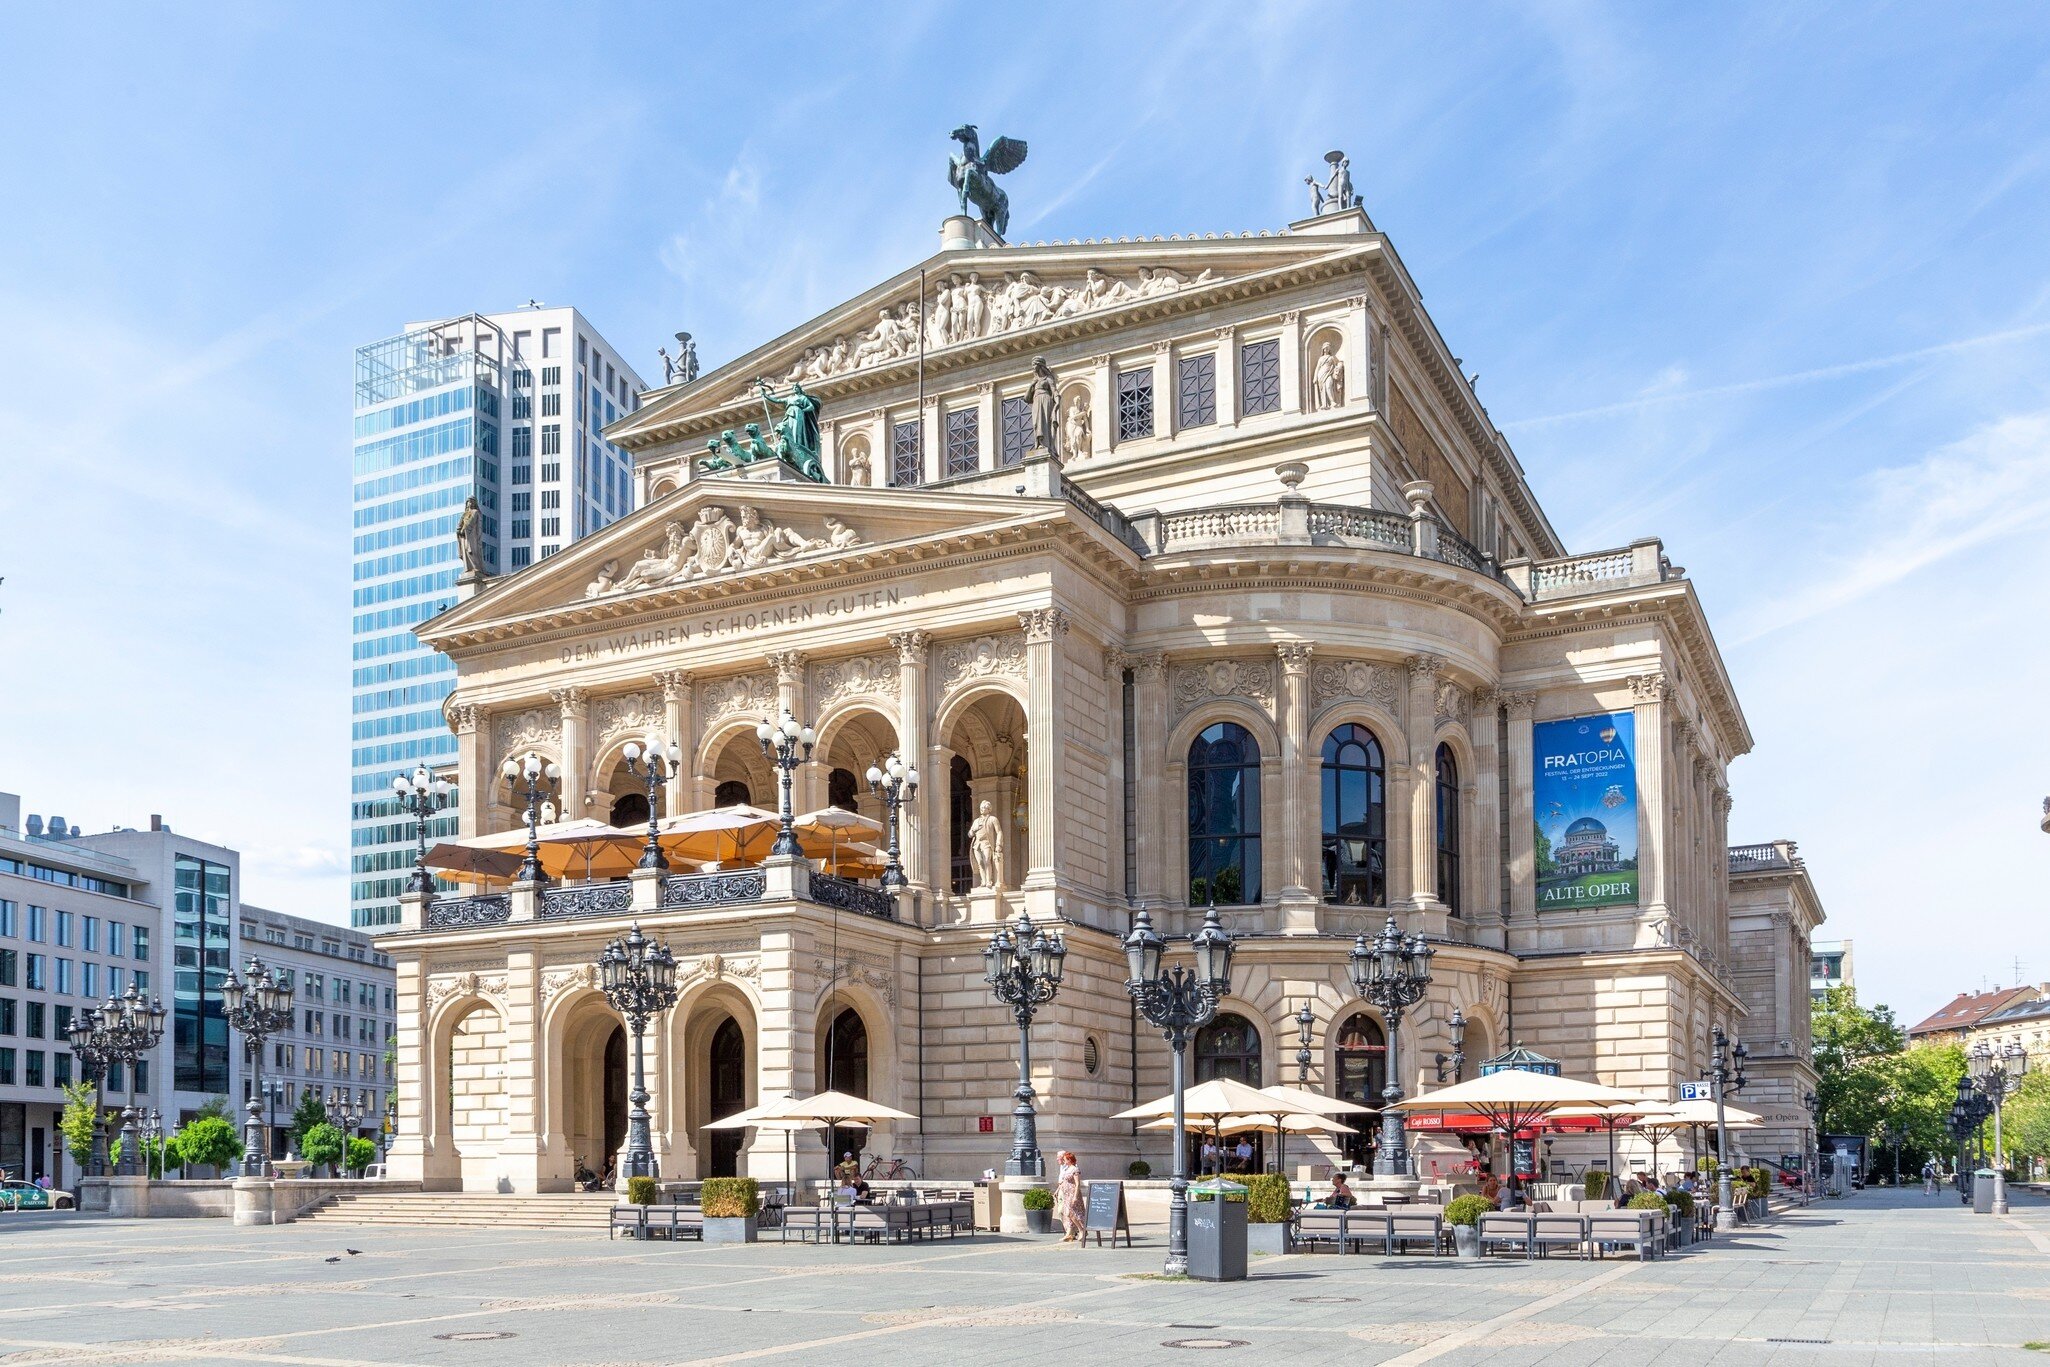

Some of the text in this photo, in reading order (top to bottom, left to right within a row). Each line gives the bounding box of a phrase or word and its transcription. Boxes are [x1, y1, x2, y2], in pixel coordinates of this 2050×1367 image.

[561, 643, 599, 664] DEM
[608, 625, 691, 655] WAHREN
[702, 603, 813, 638] SCHOENEN
[1544, 748, 1626, 769] FRATOPIA
[1581, 763, 1626, 773] ENTDECKUNGEN
[1544, 882, 1632, 901] ALTE OPER
[1684, 1087, 1695, 1099] P
[1422, 1117, 1441, 1126] ROSSO
[1775, 1112, 1799, 1122] Opéra
